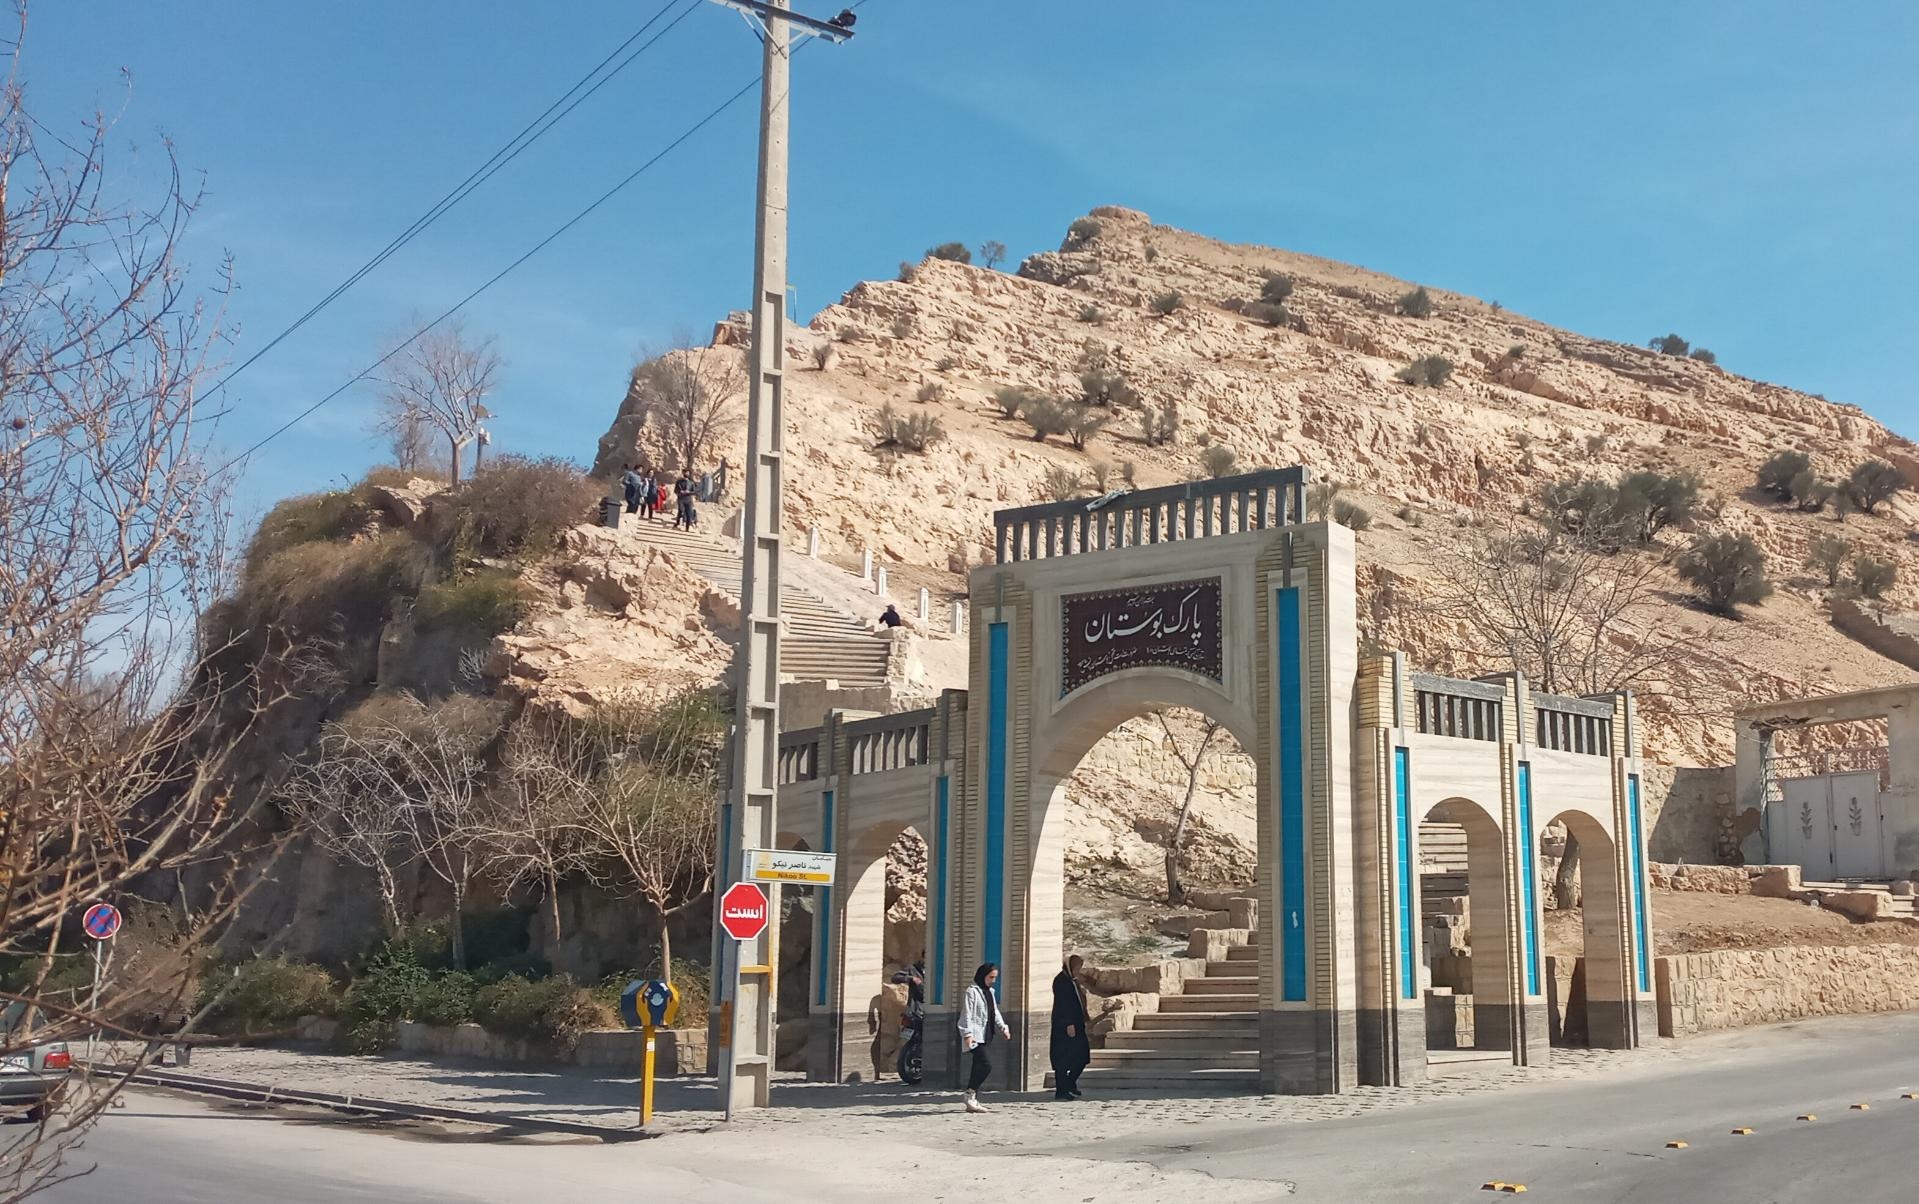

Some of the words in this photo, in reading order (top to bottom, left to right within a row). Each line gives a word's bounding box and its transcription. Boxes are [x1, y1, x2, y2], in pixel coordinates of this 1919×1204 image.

[1084, 607, 1163, 643] بوستان
[1163, 588, 1202, 646] پارک
[771, 860, 787, 869] نیکو
[788, 861, 807, 870] ناصر
[725, 904, 763, 920] ایست
